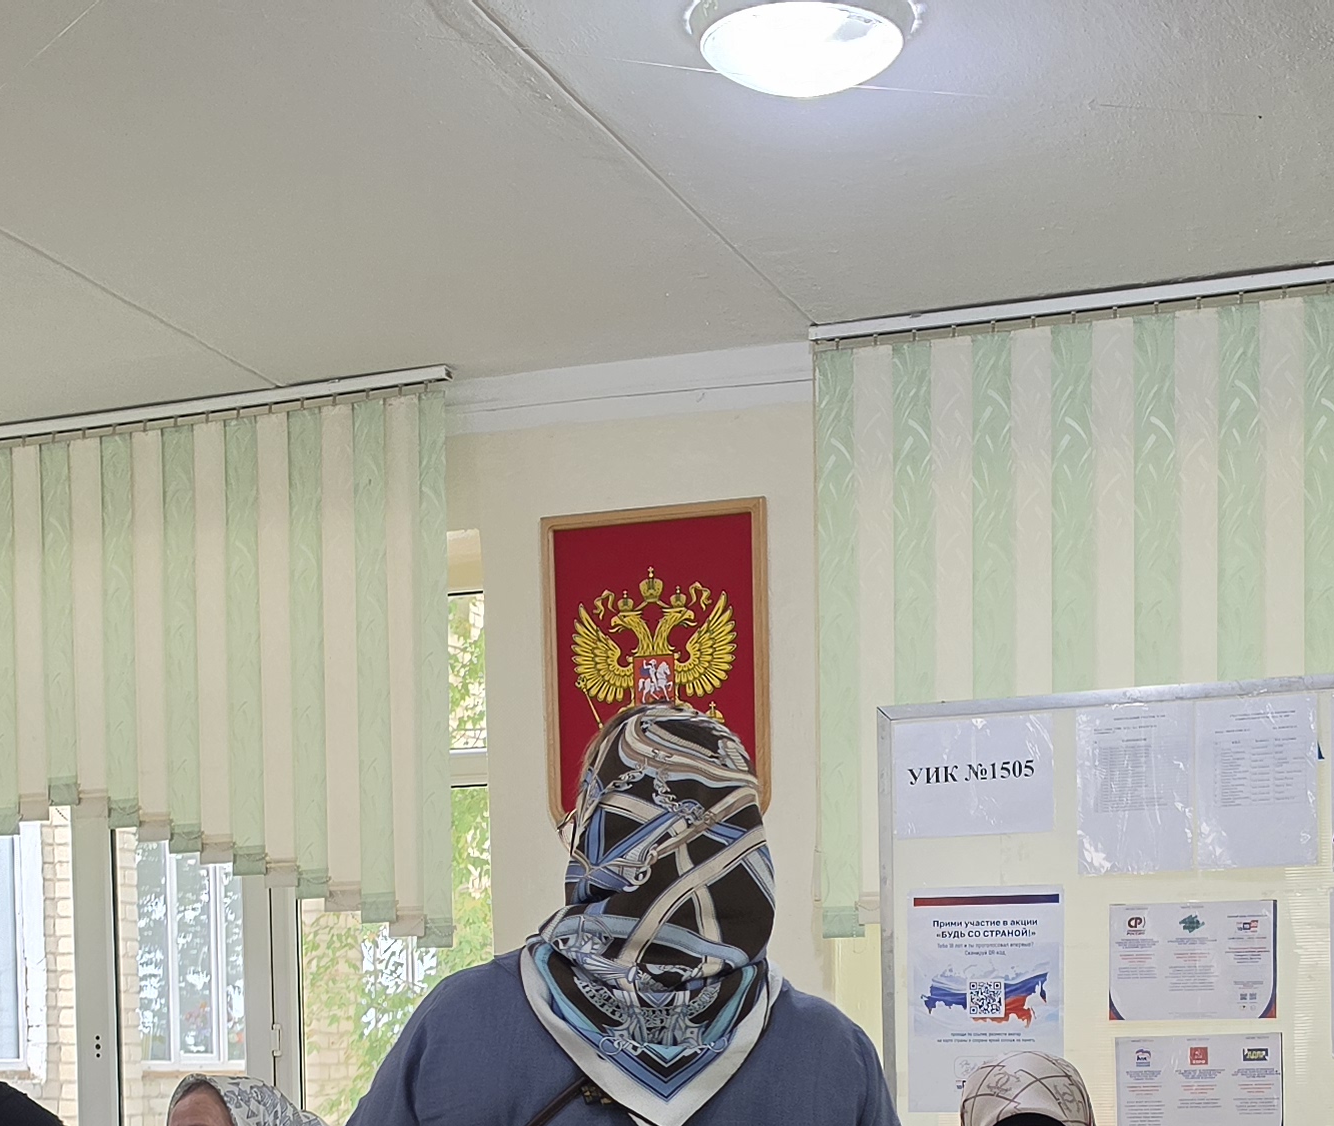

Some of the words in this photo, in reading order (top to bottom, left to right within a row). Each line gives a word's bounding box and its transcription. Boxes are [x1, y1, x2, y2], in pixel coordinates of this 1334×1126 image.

[908, 765, 958, 785] УИК
[965, 760, 1035, 782] №1505
[932, 920, 962, 929] Прими
[964, 920, 1001, 928] участие
[1010, 919, 1038, 927] акции
[936, 931, 966, 939] «БУДЬ
[983, 928, 1036, 937] СТРАНОЙ!»
